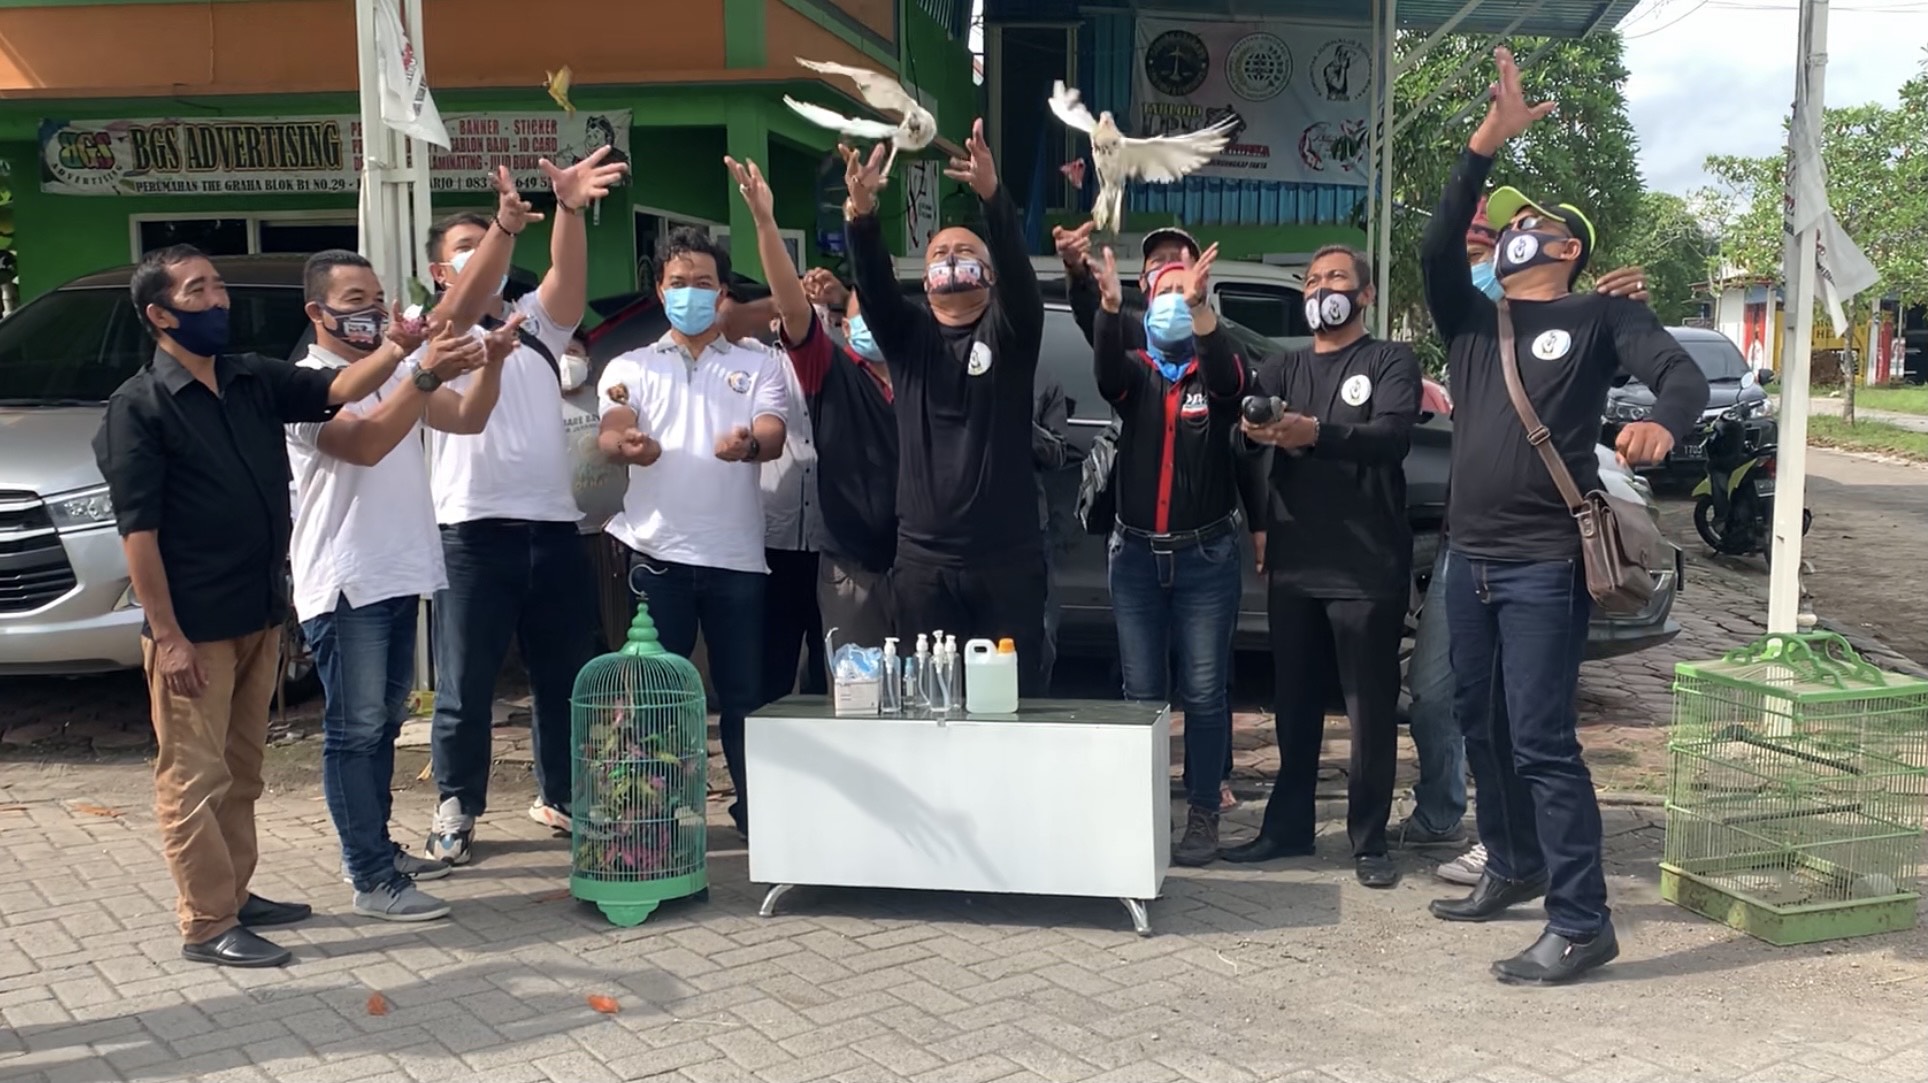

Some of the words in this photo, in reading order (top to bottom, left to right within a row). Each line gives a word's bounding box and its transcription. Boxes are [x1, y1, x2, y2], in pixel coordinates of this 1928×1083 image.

[459, 119, 499, 135] BANNER
[513, 118, 558, 135] STICKER
[58, 131, 115, 169] BGS
[130, 125, 181, 171] BGS
[184, 122, 342, 171] ADVERTISING
[486, 137, 510, 152] BAJU
[519, 137, 530, 152] ID
[533, 137, 558, 152] CARD
[136, 180, 198, 193] PERUMAHAN
[202, 180, 221, 192] THE
[225, 179, 262, 192] GRAHA
[265, 178, 293, 191] BLOK
[313, 178, 345, 191] NO.29
